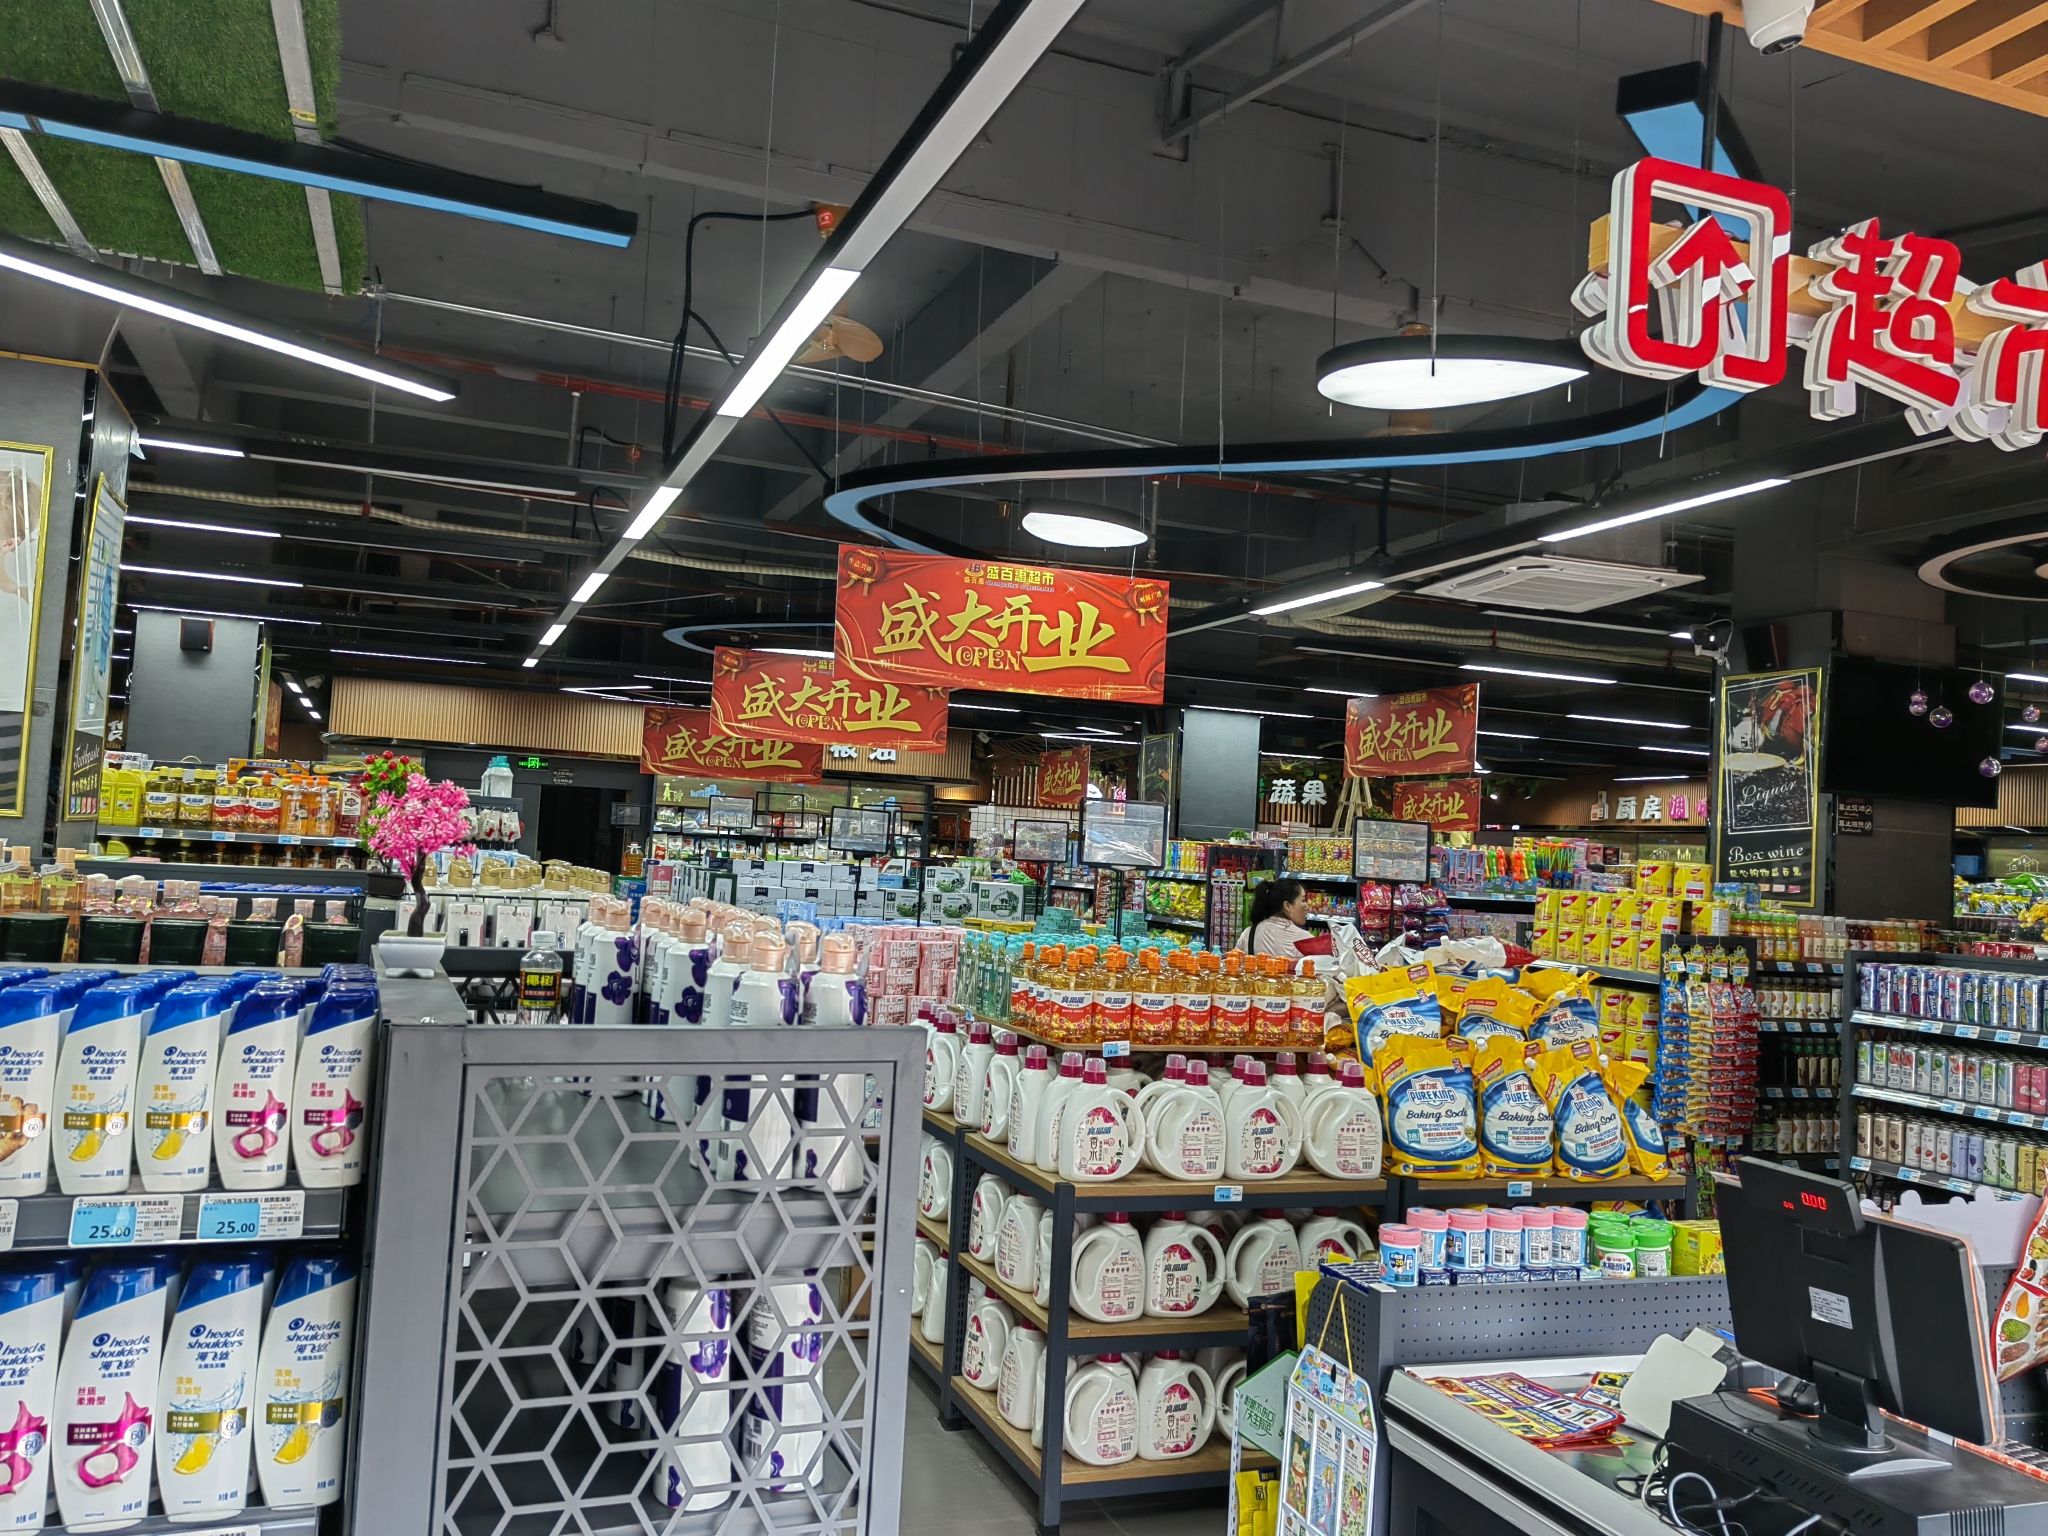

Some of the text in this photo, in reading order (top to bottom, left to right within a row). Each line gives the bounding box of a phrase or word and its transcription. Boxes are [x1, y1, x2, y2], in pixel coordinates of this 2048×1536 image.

[986, 565, 1055, 586] 盛百惠超市
[873, 582, 1131, 673] 盛大开业
[956, 644, 1022, 672] OPEN
[737, 671, 922, 733] 盛大开业
[795, 713, 844, 732] OPEN
[1356, 707, 1460, 762] 盛大开业
[661, 725, 803, 769] 盛大开业
[705, 756, 744, 770] OPEN
[1270, 778, 1328, 806] 蔬果
[1737, 780, 1797, 808] Liquor
[1402, 791, 1470, 823] 盛大开业
[1728, 845, 1805, 863] Box wine
[1061, 995, 1085, 1005] 亮晶晶
[1104, 996, 1127, 1005] 亮晶晶
[1141, 998, 1165, 1007] 亮晶晶
[1311, 1001, 1324, 1010] 亮晶
[81, 1058, 126, 1066] shoulders
[161, 1058, 207, 1066] shoulders
[241, 1056, 285, 1064] shoulders
[319, 1056, 362, 1064] shoulders
[1409, 1089, 1456, 1102] PUREKING
[1406, 1108, 1468, 1122] Baking Soda
[1498, 1111, 1535, 1126] Baking
[1087, 1126, 1112, 1136] 亮晶晶
[1250, 1126, 1274, 1136] 亮晶晶
[1089, 1136, 1100, 1161] 香水
[1252, 1136, 1263, 1161] 香水
[1801, 1192, 1828, 1211] 0.00
[88, 1225, 131, 1239] 25.00
[215, 1221, 256, 1235] 25.00
[1163, 1263, 1189, 1273] 亮晶晶
[1165, 1273, 1176, 1299] 香水
[285, 1331, 341, 1342] shoulders
[186, 1339, 244, 1350] shoulders
[89, 1346, 150, 1359] shoulders
[0, 1354, 44, 1366] oulders
[77, 1386, 97, 1396] 丝质
[75, 1396, 106, 1407] 柔滑型
[1165, 1402, 1189, 1414] 亮晶晶
[226, 1422, 238, 1432] 60
[1167, 1413, 1177, 1440] 香水
[131, 1428, 144, 1439] 60
[25, 1439, 39, 1451] 60
